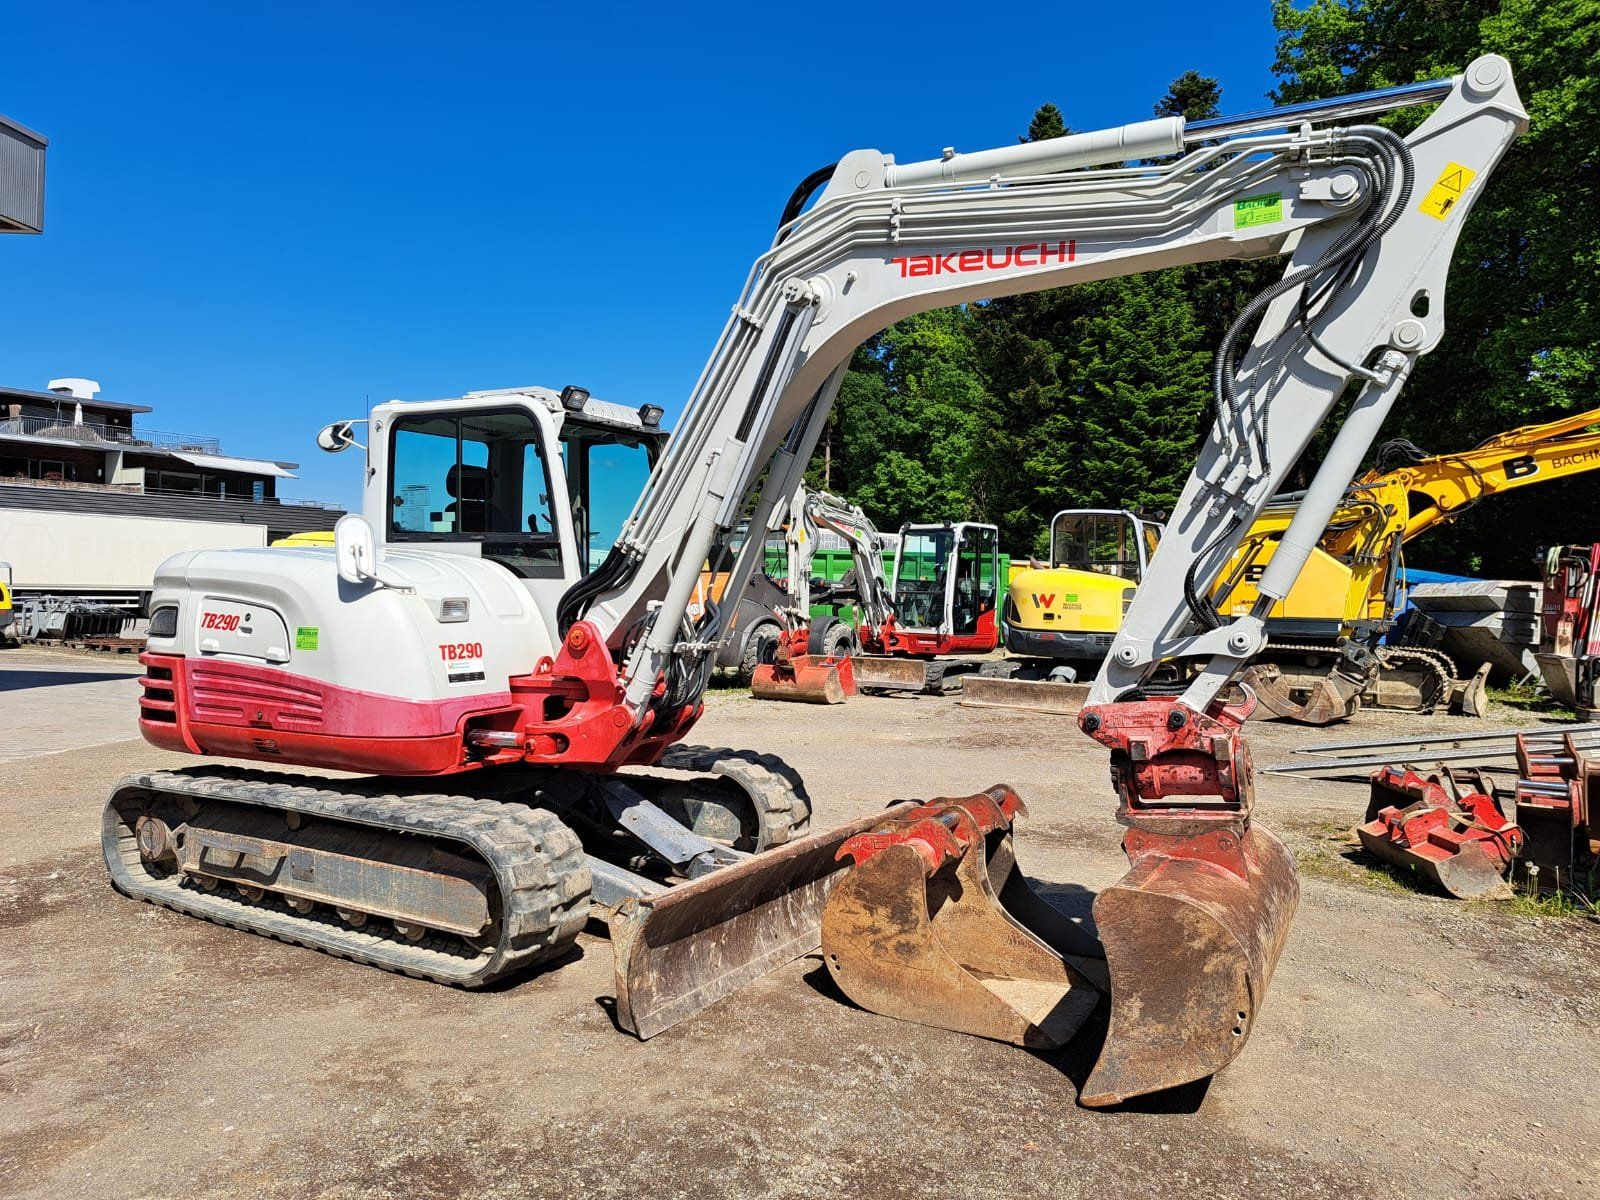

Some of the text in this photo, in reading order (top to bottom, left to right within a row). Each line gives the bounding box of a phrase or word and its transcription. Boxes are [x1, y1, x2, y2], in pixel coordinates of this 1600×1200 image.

[890, 240, 1077, 278] TAKEUCHI
[1502, 455, 1539, 480] B
[201, 612, 240, 632] TB290
[438, 642, 483, 660] TB290
